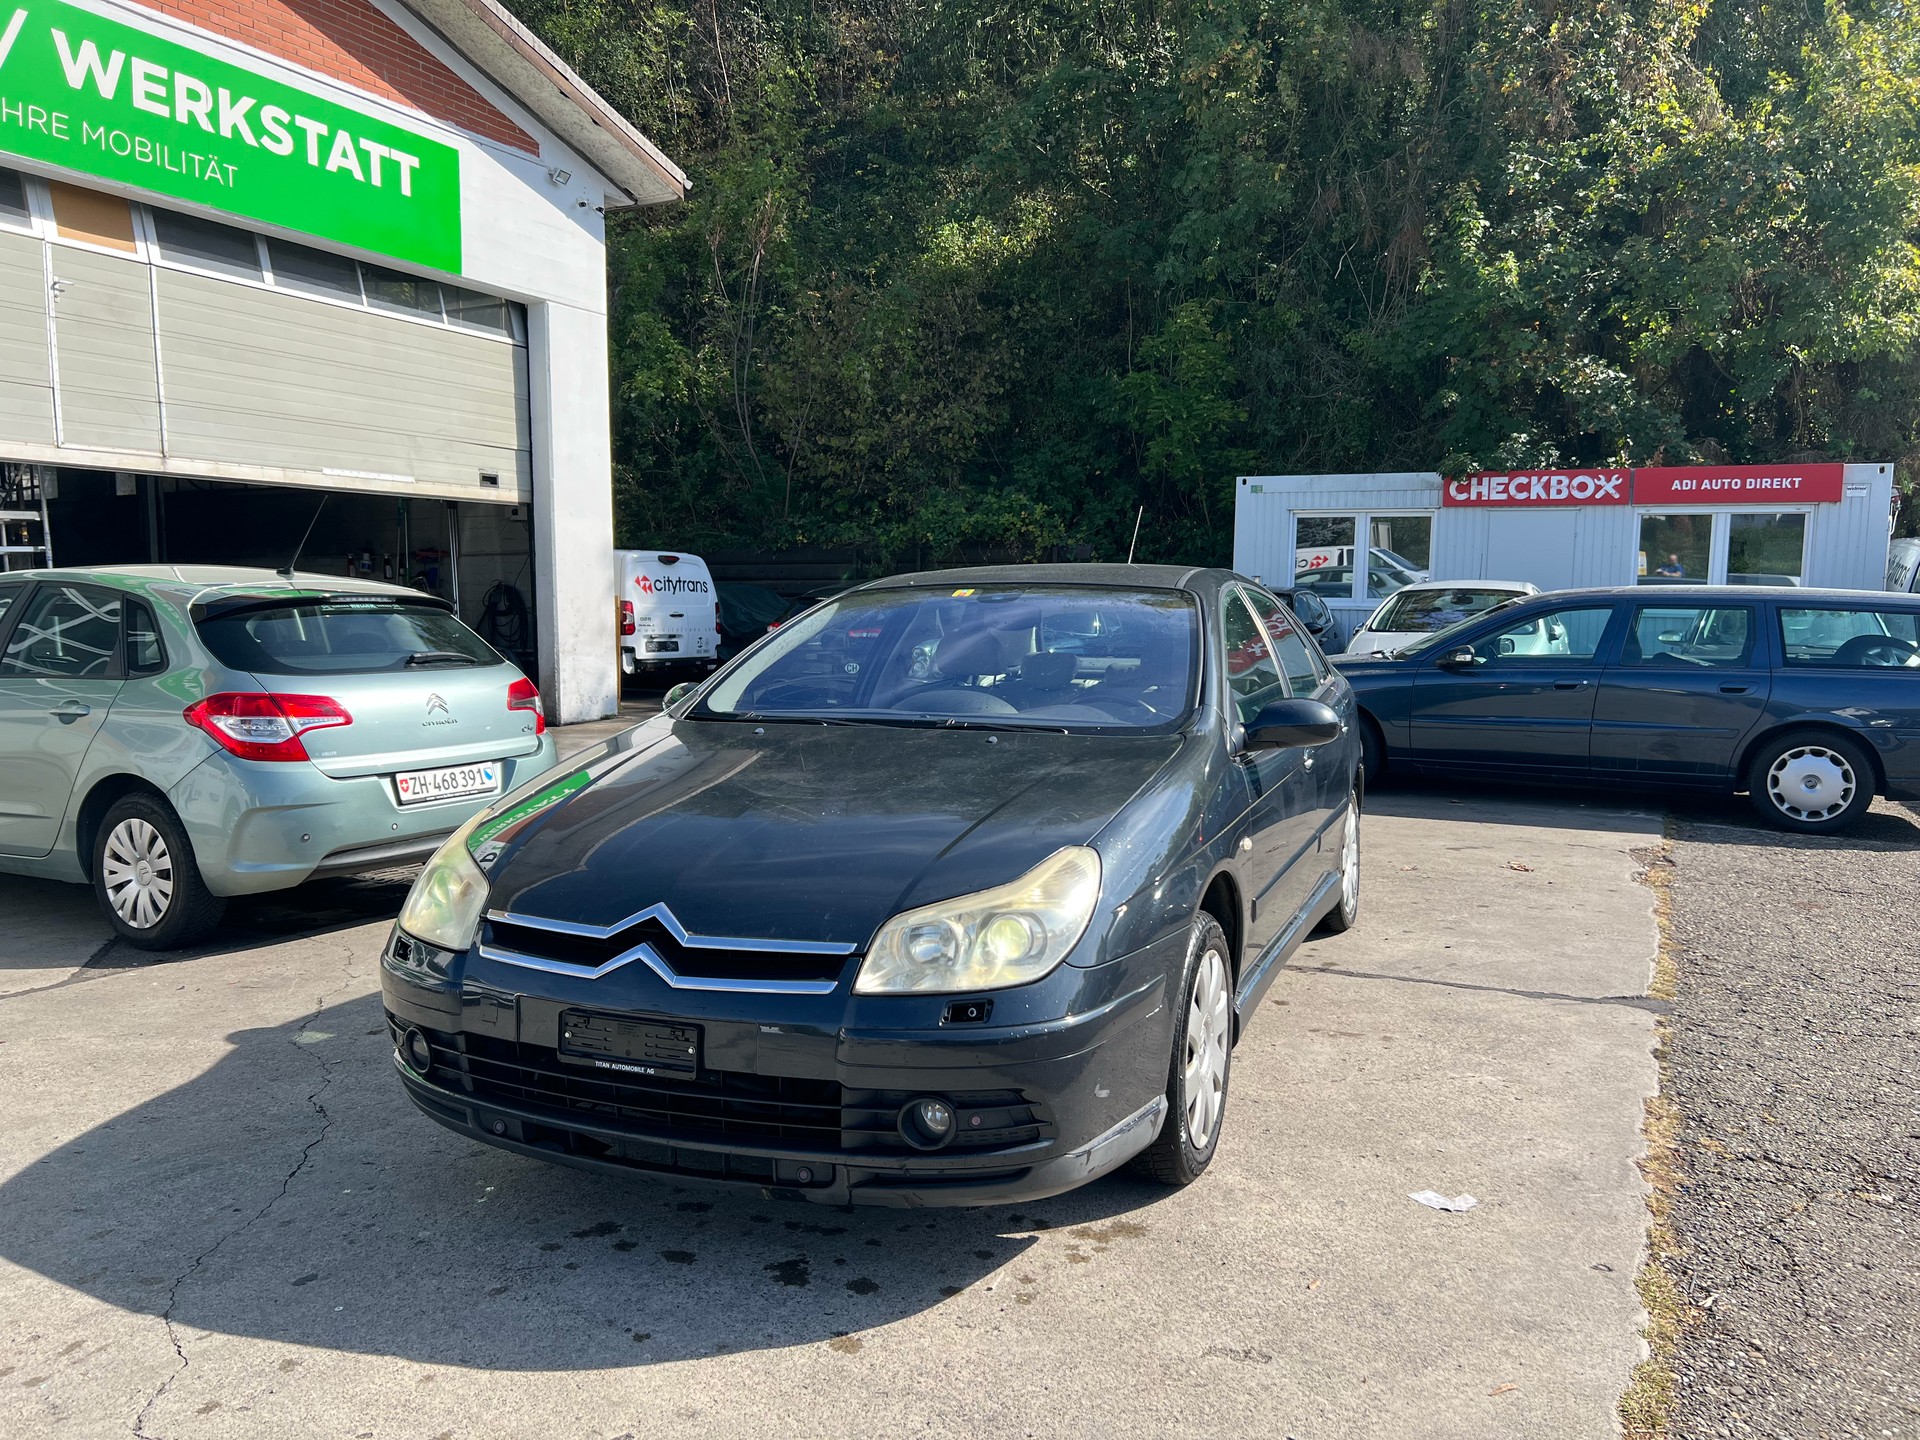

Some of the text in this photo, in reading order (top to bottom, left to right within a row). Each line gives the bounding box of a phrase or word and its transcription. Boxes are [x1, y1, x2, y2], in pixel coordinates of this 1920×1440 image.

[51, 28, 420, 197] WERKSTATT
[2, 97, 238, 188] HRE MOBILITÄT
[1449, 474, 1623, 500] CHECKBOX
[1671, 477, 1802, 490] ADI AUTO DIREKT
[653, 576, 708, 595] citytrans
[846, 663, 858, 673] CH
[595, 1060, 610, 1069] TITAN
[611, 1063, 645, 1073] AUTOMOBILE
